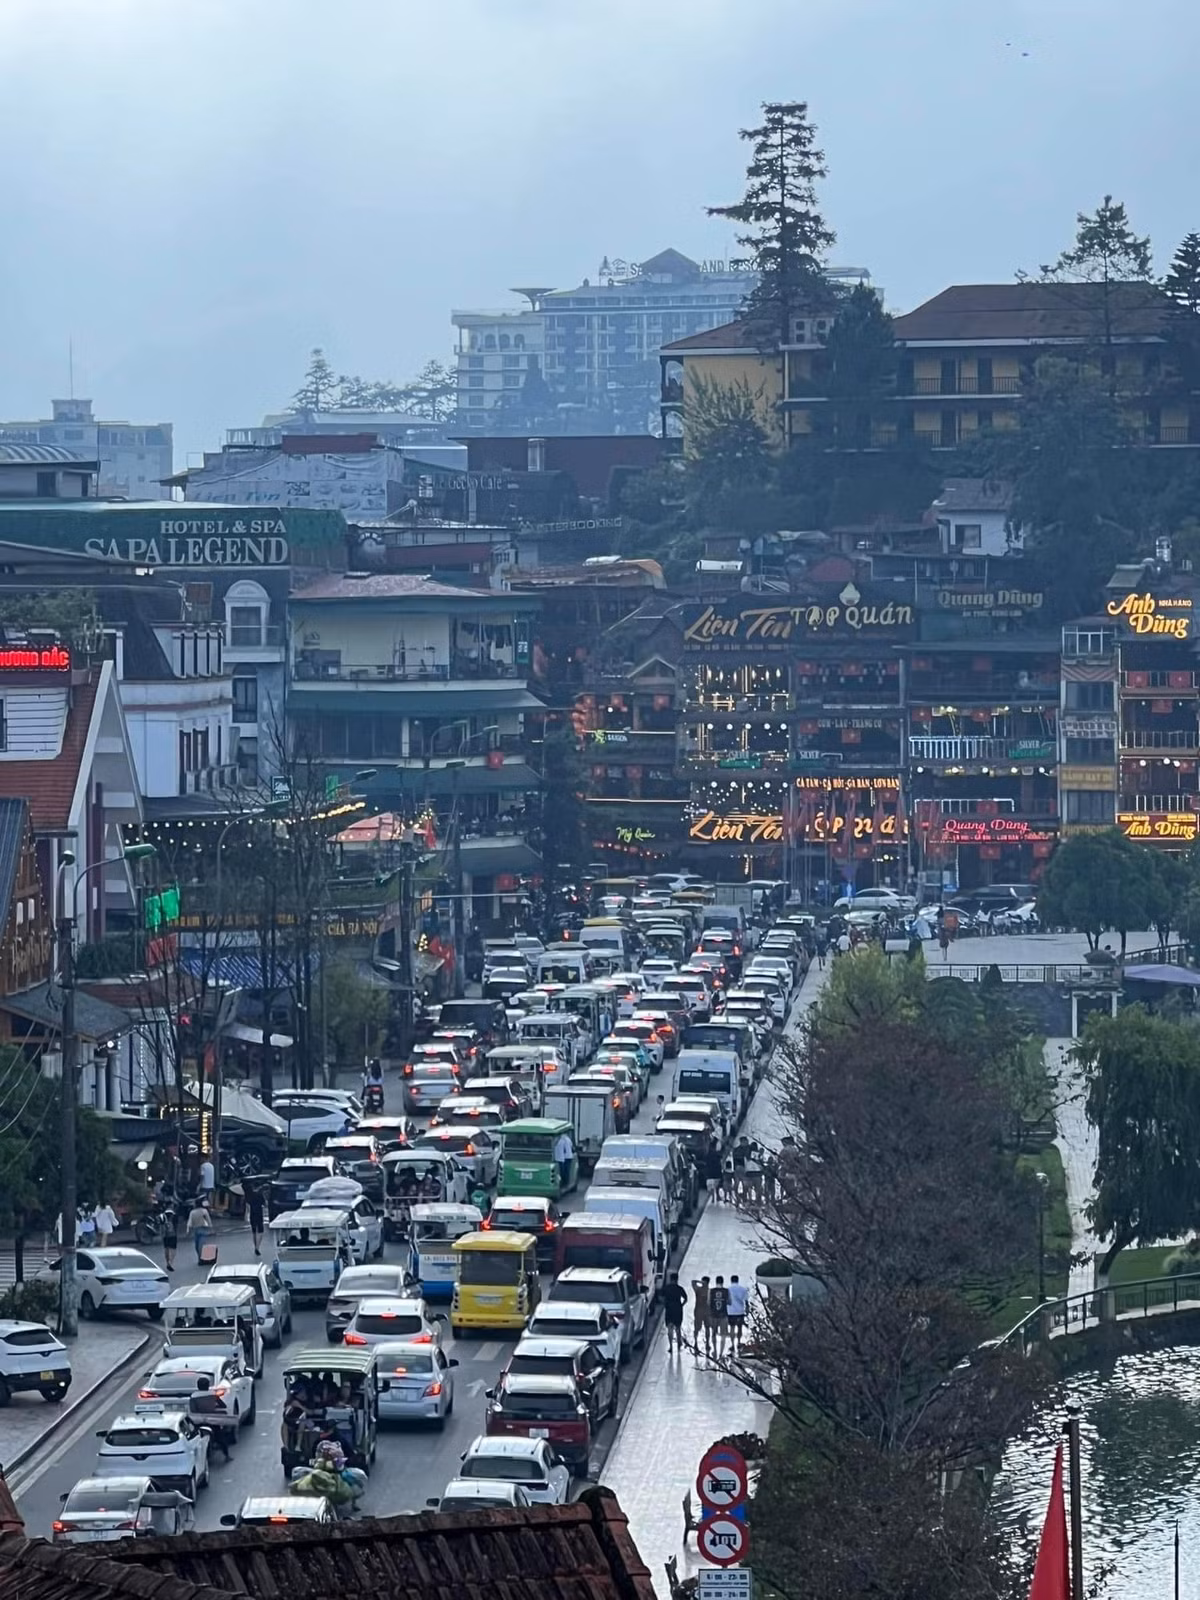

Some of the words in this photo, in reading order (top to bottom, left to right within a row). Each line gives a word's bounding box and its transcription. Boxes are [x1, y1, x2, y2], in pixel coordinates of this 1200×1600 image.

[701, 259, 725, 273] AND
[160, 520, 229, 534] HOTEL
[232, 520, 247, 534] &
[250, 520, 287, 534] SPA
[84, 537, 162, 565] SAPA
[167, 537, 289, 565] LEGEND
[1107, 593, 1156, 615] Anh
[684, 605, 739, 642] Liên
[740, 606, 795, 641] Tôn
[1129, 613, 1190, 639] Dũng
[689, 810, 744, 842] Liên
[942, 819, 988, 837] Quang
[1154, 821, 1197, 840] Dũng
